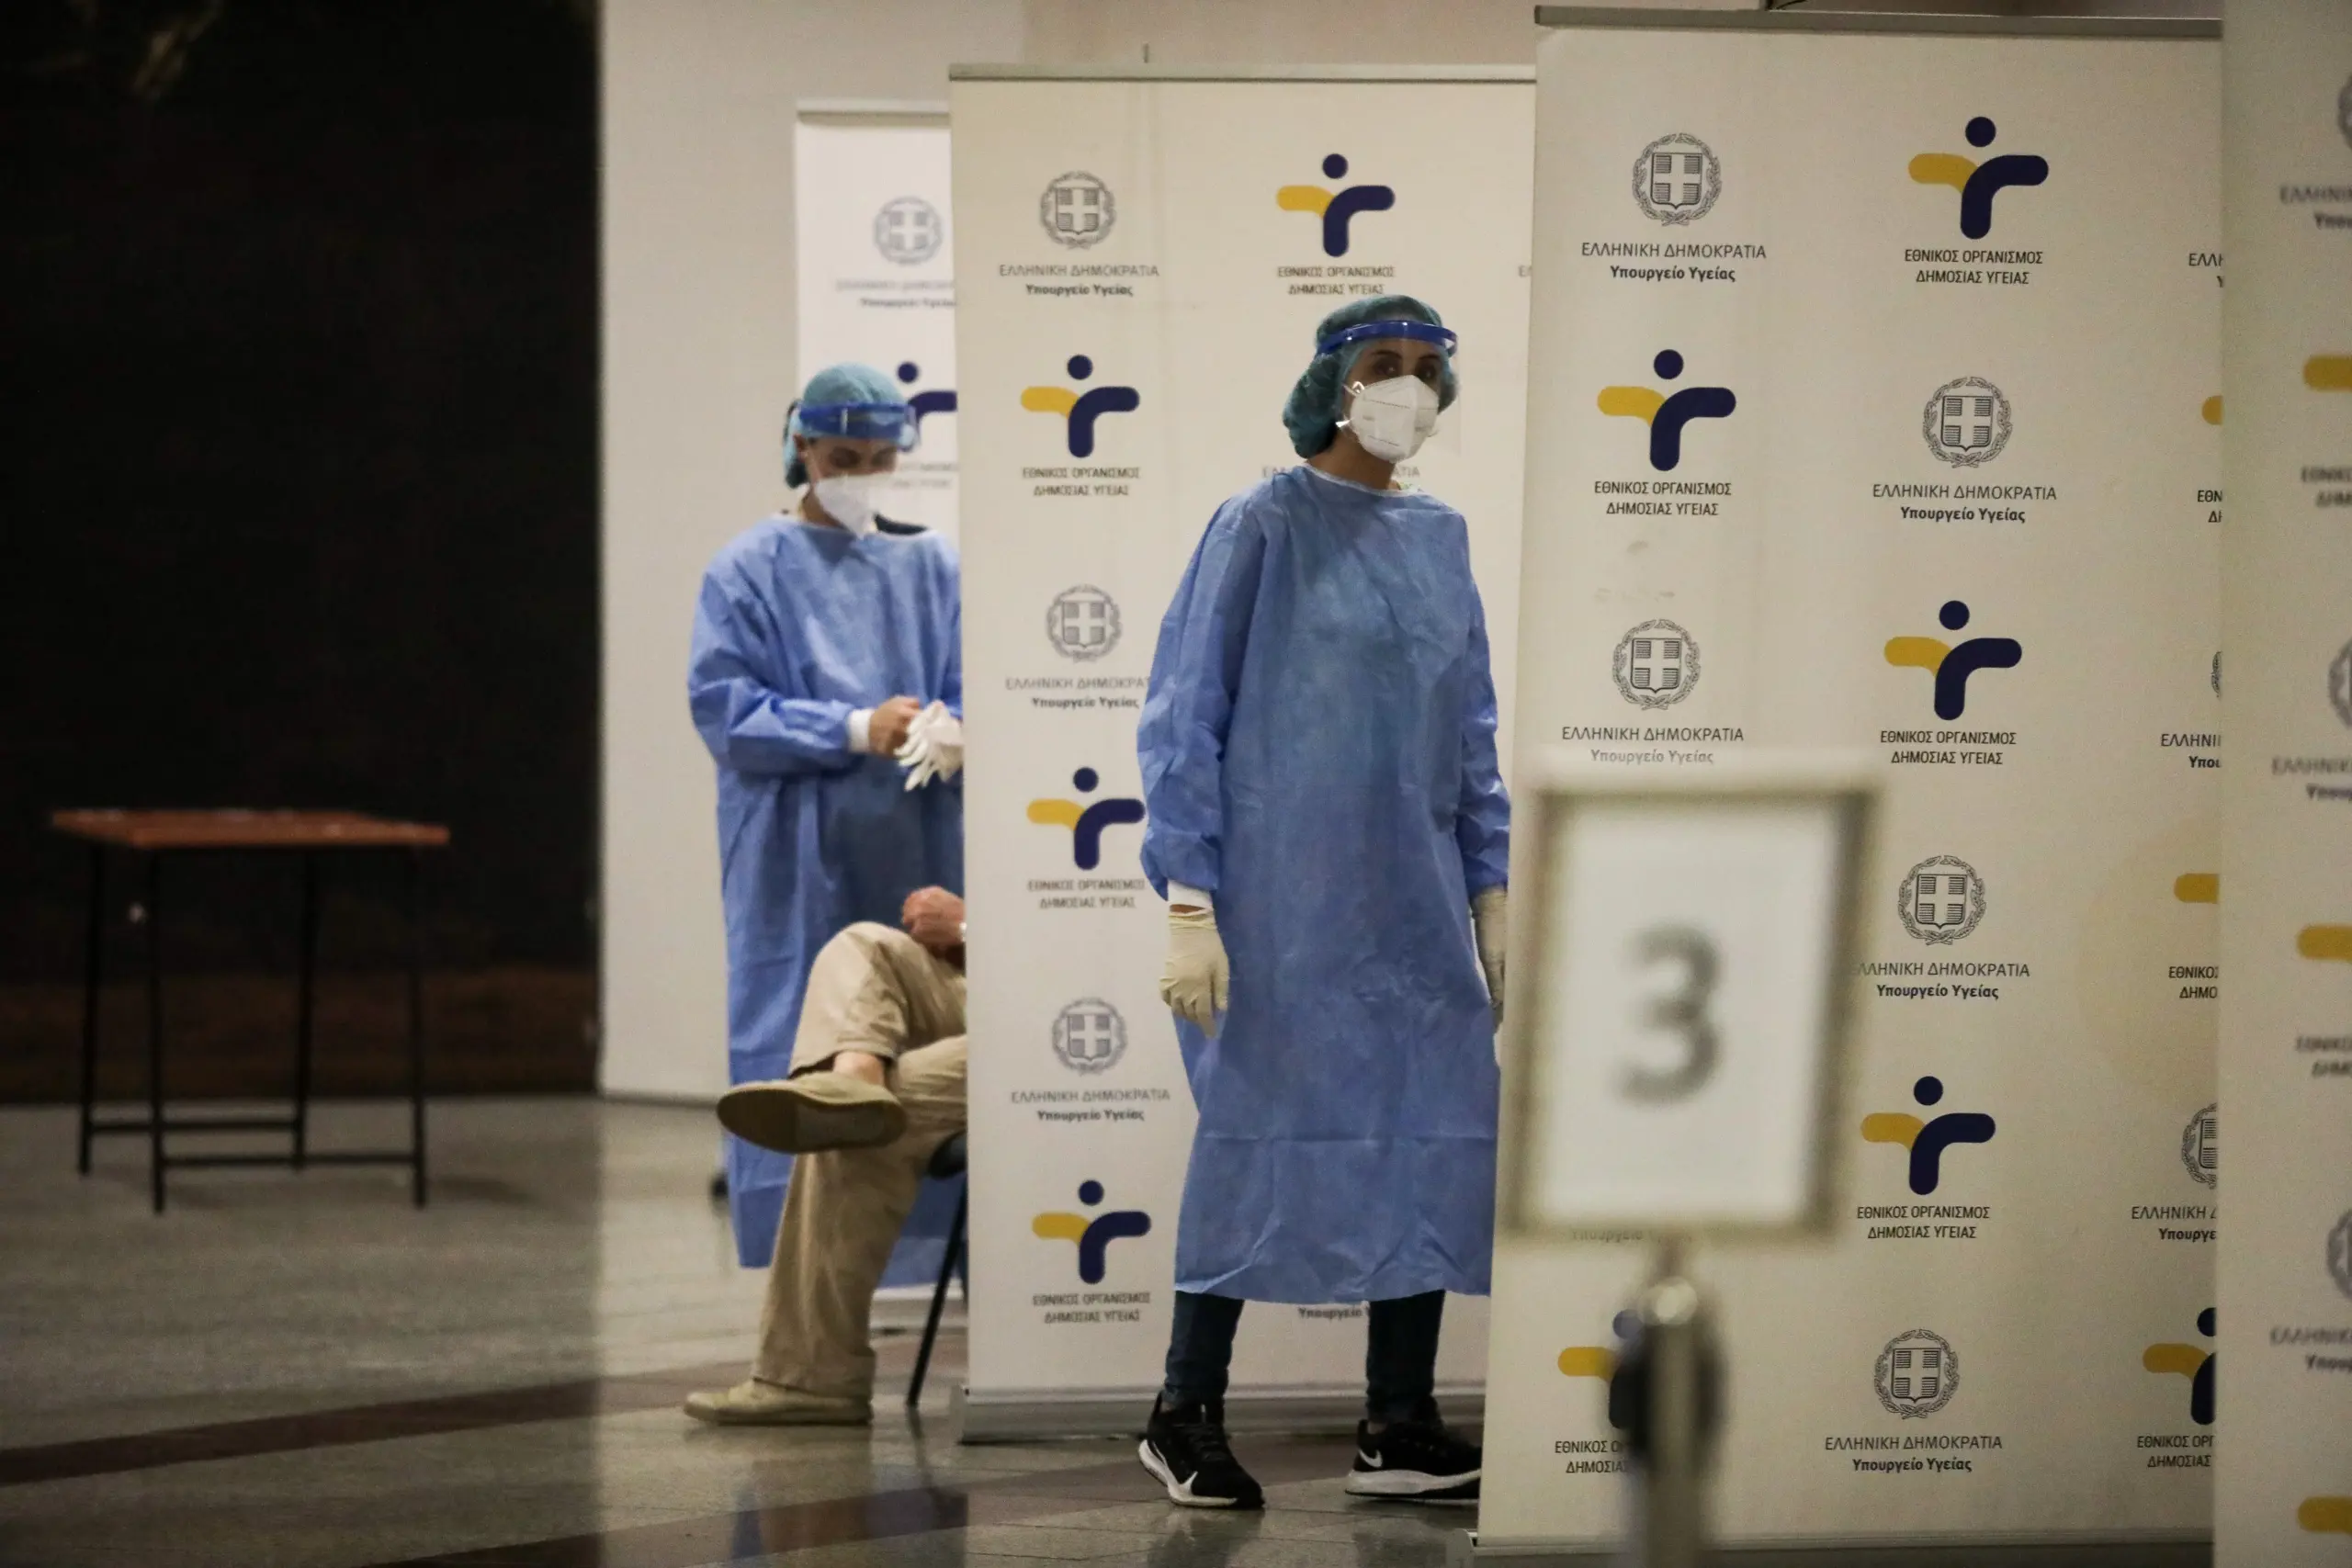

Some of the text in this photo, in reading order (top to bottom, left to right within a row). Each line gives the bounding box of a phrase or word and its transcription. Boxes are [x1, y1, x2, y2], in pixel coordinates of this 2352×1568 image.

[1582, 243, 1766, 258] ΕΛΛΗΝΙΚΗ ΔΗΜΟΚΡΑΤΙΑ
[1905, 249, 2043, 264] ΕΘΝΙΚΟΣ ΟΡΓΑΝΙΣΜΟΣ
[1000, 265, 1159, 276] ΕΛΛΗΝΙΚΗ ΔΗΜΟΚΡΑΤΙΑ
[1278, 266, 1394, 277] ΕΘΝΙΚΟΣ ΟΡΓΑΝΙΣΜΟΣ
[1611, 265, 1736, 282] Υπουργείο Υγείας
[1916, 270, 2030, 284] ΔΗΜΟΣΙΑΣ ΥΓΕΙΑΣ
[1026, 285, 1133, 297] Υπουργείο Υγείας
[1288, 284, 1384, 295] ΔΗΜΟΣΙΑΣ ΥΓΕΙΑΣ
[1023, 468, 1139, 479] ΕΘΝΙΚΟΣ ΟΡΓΑΝΙΣΜΟΣ
[1034, 485, 1128, 496] ΔΗΜΟΣΙΑΣ ΥΓΕΙΑΣ
[1595, 481, 1731, 495] ΕΘΝΙΚΟΣ ΟΡΓΑΝΙΣΜΟΣ
[1873, 484, 2056, 500] ΕΛΛΗΝΙΚΗ ΔΗΜΟΚΡΑΤΙΑ
[1607, 502, 1718, 515] ΔΗΜΟΣΙΑΣ ΥΓΕΙΑΣ
[1901, 507, 2025, 523] Υπουργείο Υγείας
[1005, 678, 1073, 690] ΕΛΛΗΝΙΚΗ
[1032, 697, 1139, 709] Υπουργείο Υγείας
[1563, 727, 1744, 741] ΕΛΛΗΝΙΚΗ ΔΗΜΟΚΡΑΤΙΑ
[1881, 731, 2017, 744] ΕΘΝΙΚΟΣ ΟΡΓΑΝΙΣΜΟΣ
[1590, 750, 1713, 764] Υπουργείο Υγείας
[1891, 751, 2003, 764] ΔΗΜΟΣΙΑΣ ΥΓΕΙΑΣ
[1860, 963, 2030, 976] ΛΛΗΝΙΚΗ ΔΗΜΟΚΡΑΤΙΑ
[1877, 985, 1998, 999] Υπουργείο Υγείας
[1614, 920, 1722, 1106] 3
[1012, 1089, 1170, 1103] ΕΛΛΗΝΙΚΗ ΔΗΜΟΚΡΑΤΙΑ
[1037, 1110, 1144, 1122] Υπουργείο Υγείας
[1858, 1206, 1990, 1219] ΕΘΝΙΚΟΣ ΟΡΓΑΝΙΣΜΟΣ
[2132, 1206, 2207, 1219] ΕΛΛΗΝΙΚΗ
[1868, 1225, 1976, 1238] ΔΗΜΟΣΙΑΣ ΥΓΕΙΑΣ
[1033, 1292, 1150, 1306] ΕΘΝΙΚΟΣ ΟΡΓΑΝΙΣΜΟΣ
[1045, 1309, 1139, 1324] ΔΗΜΟΣΙΑΣ ΥΓΕΙΑΣ
[1555, 1440, 1608, 1453] ΕΘΝΙΚΟΣ
[1826, 1436, 2002, 1450] ΕΛΛΗΝΙΚΗ ΔΗΜΟΚΡΑΤΙΑ
[2137, 1436, 2190, 1448] ΕΘΝΙΚΟΣ
[1566, 1461, 1624, 1473] ΔΗΜΟΣΙΑ
[1852, 1457, 1972, 1472] Υπουργείο Υγείας
[2147, 1455, 2211, 1467] ΔΗΜΟΣΙΑΣ
